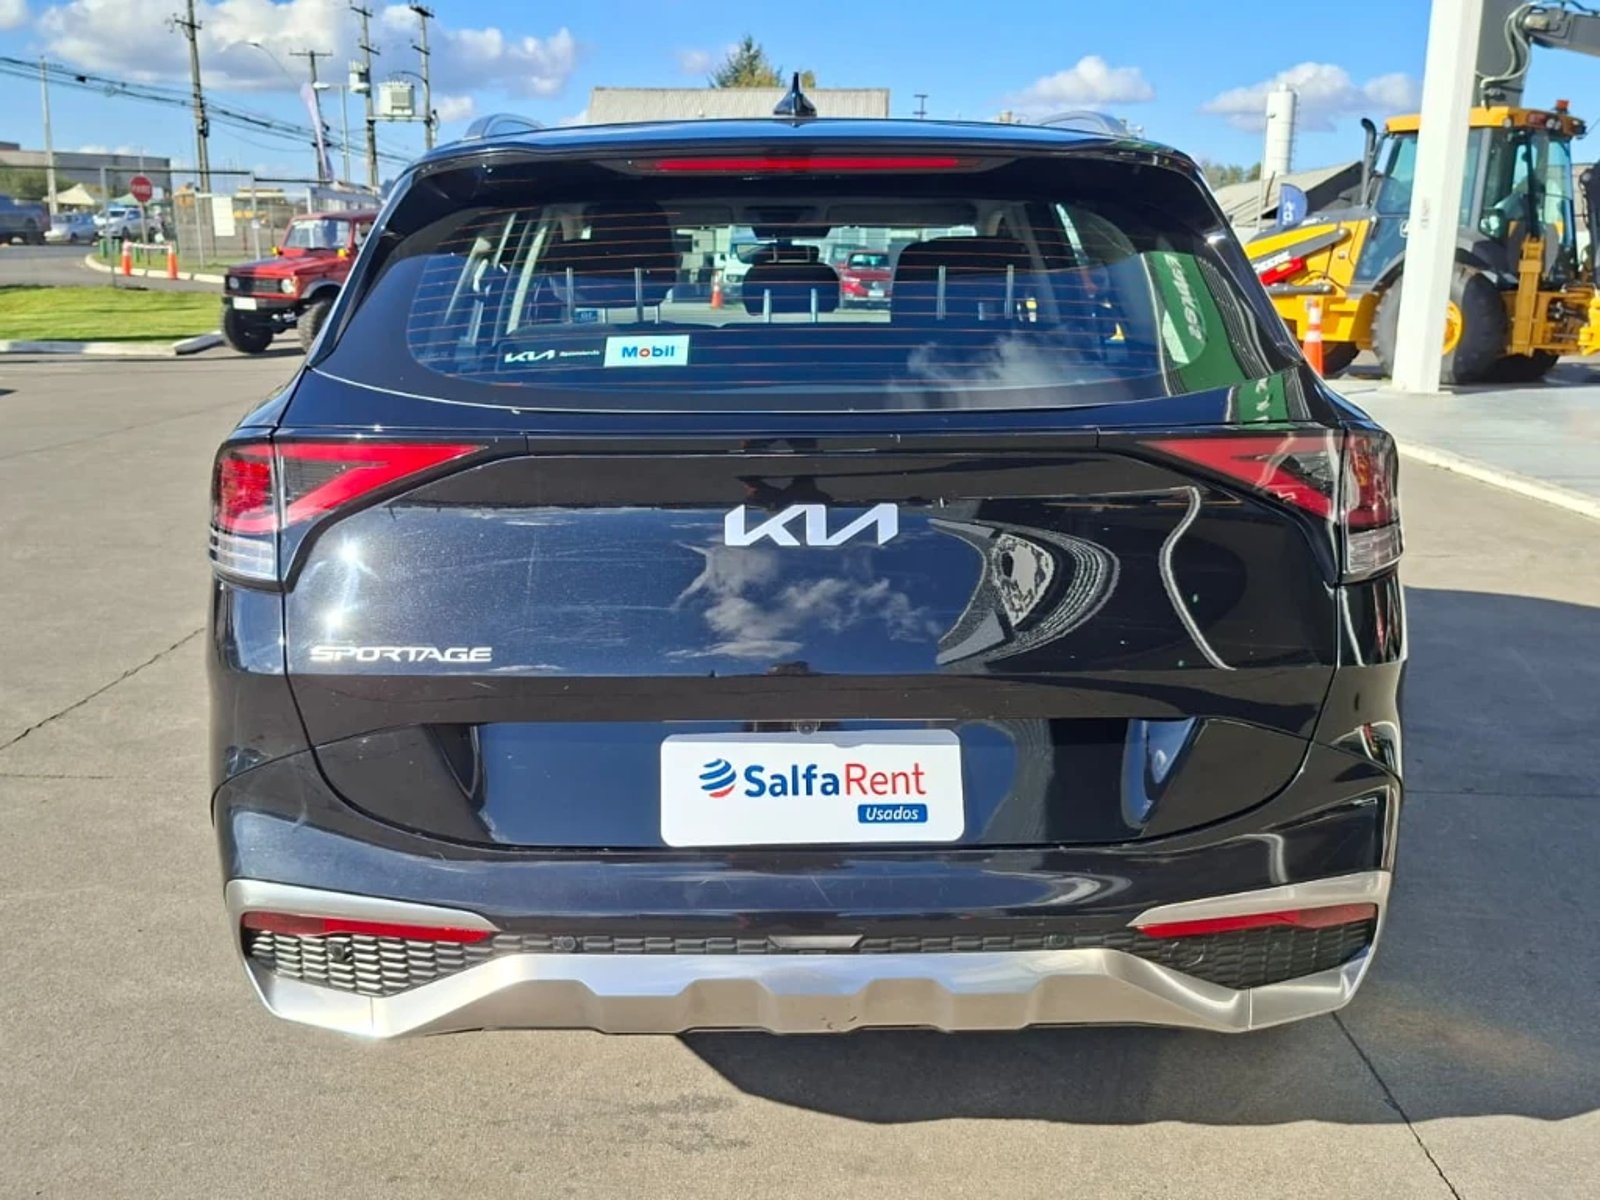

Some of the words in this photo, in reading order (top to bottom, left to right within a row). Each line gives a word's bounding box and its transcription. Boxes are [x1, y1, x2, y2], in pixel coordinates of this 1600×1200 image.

[504, 349, 556, 364] KIA
[621, 345, 675, 359] Mobil
[724, 503, 898, 547] KIA
[309, 645, 493, 663] SPORTAGE
[743, 761, 927, 798] SalfaRent
[865, 805, 920, 821] Usados
